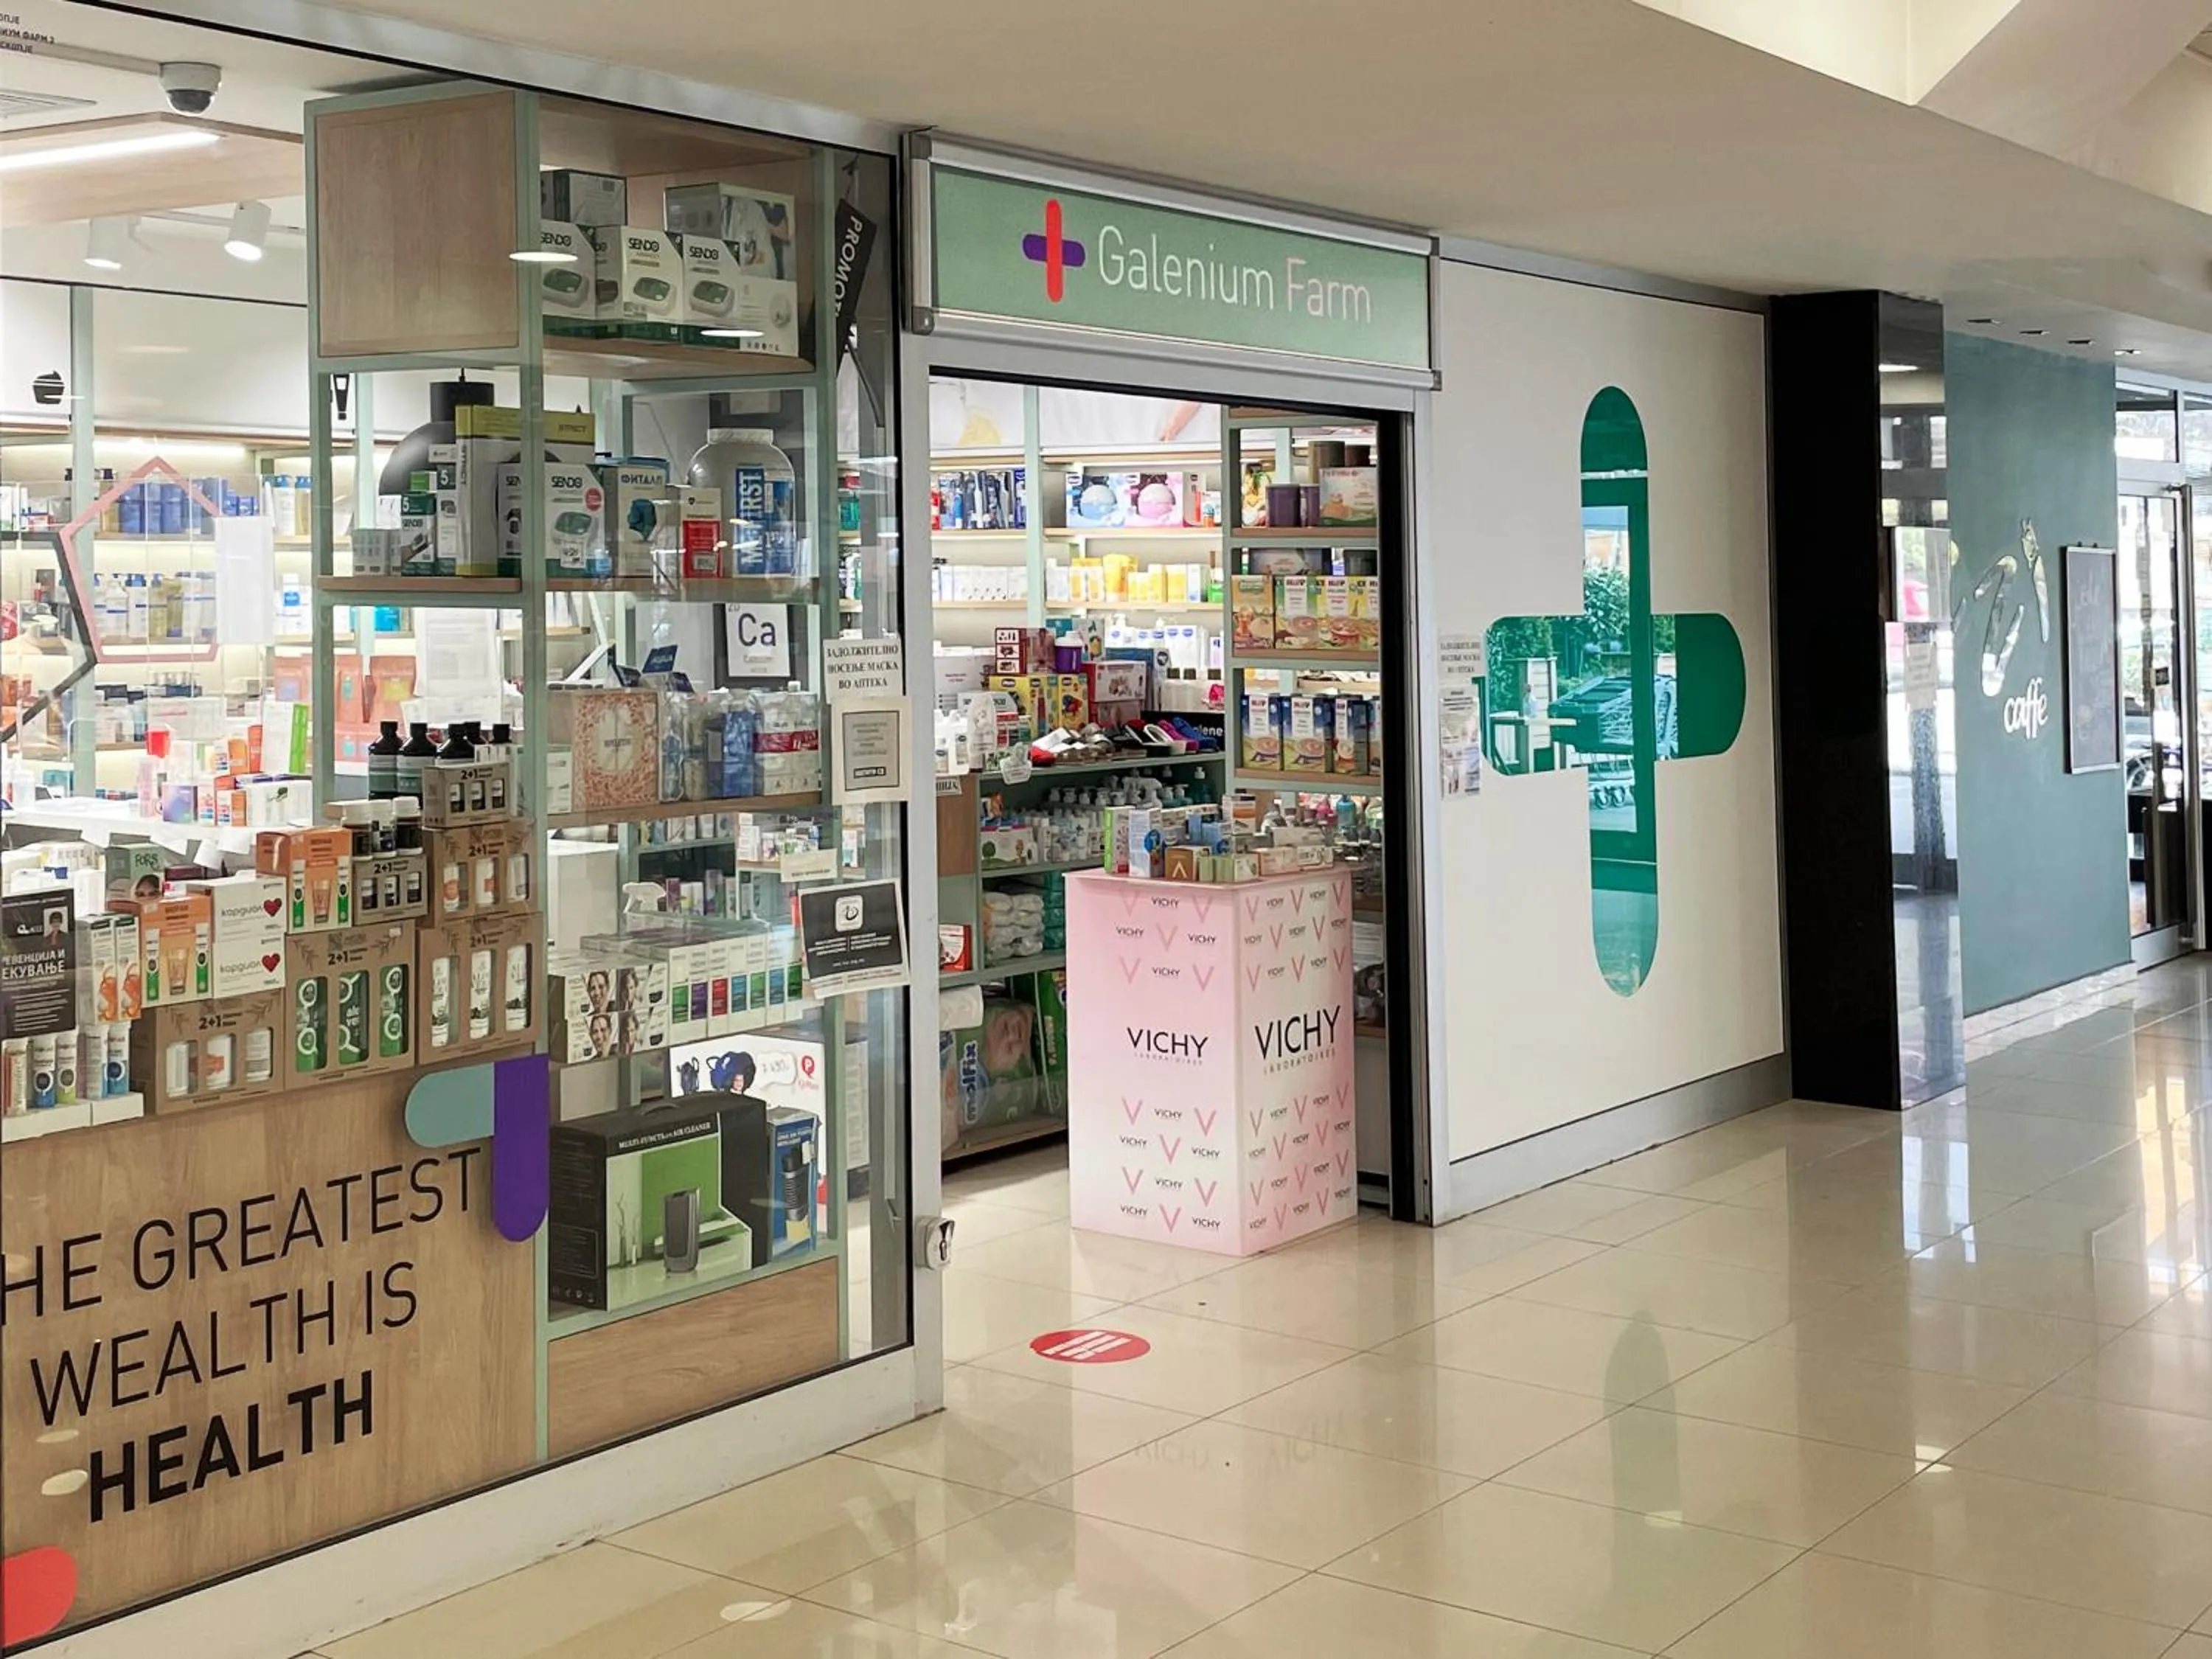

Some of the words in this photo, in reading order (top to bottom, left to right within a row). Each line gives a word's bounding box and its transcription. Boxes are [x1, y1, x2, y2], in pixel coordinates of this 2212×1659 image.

[628, 237, 661, 252] SENDO
[689, 245, 720, 260] SENDO
[1098, 224, 1275, 311] Galenium
[1285, 256, 1373, 324] Farm
[739, 613, 776, 647] Ca
[1152, 897, 1179, 908] VICHY
[1116, 927, 1144, 938] VICHY
[1188, 934, 1216, 945] VICHY
[1, 960, 66, 980] ЕКУВАЊЕ
[1152, 967, 1180, 977] VICHY
[1254, 1004, 1341, 1061] VICHY
[1126, 1026, 1208, 1059] VICHY
[1154, 1108, 1182, 1119] VICHY
[1120, 1135, 1147, 1147] VICHY
[1192, 1147, 1220, 1158] VICHY
[1155, 1179, 1183, 1189] VICHY
[1121, 1206, 1147, 1217] VICHY
[1192, 1217, 1220, 1228] VICHY
[0, 1233, 102, 1326] HE
[132, 1147, 481, 1290] GREATEST
[29, 1280, 335, 1427] WEALTH
[366, 1262, 417, 1336] IS
[89, 1369, 373, 1523] HEALTH
